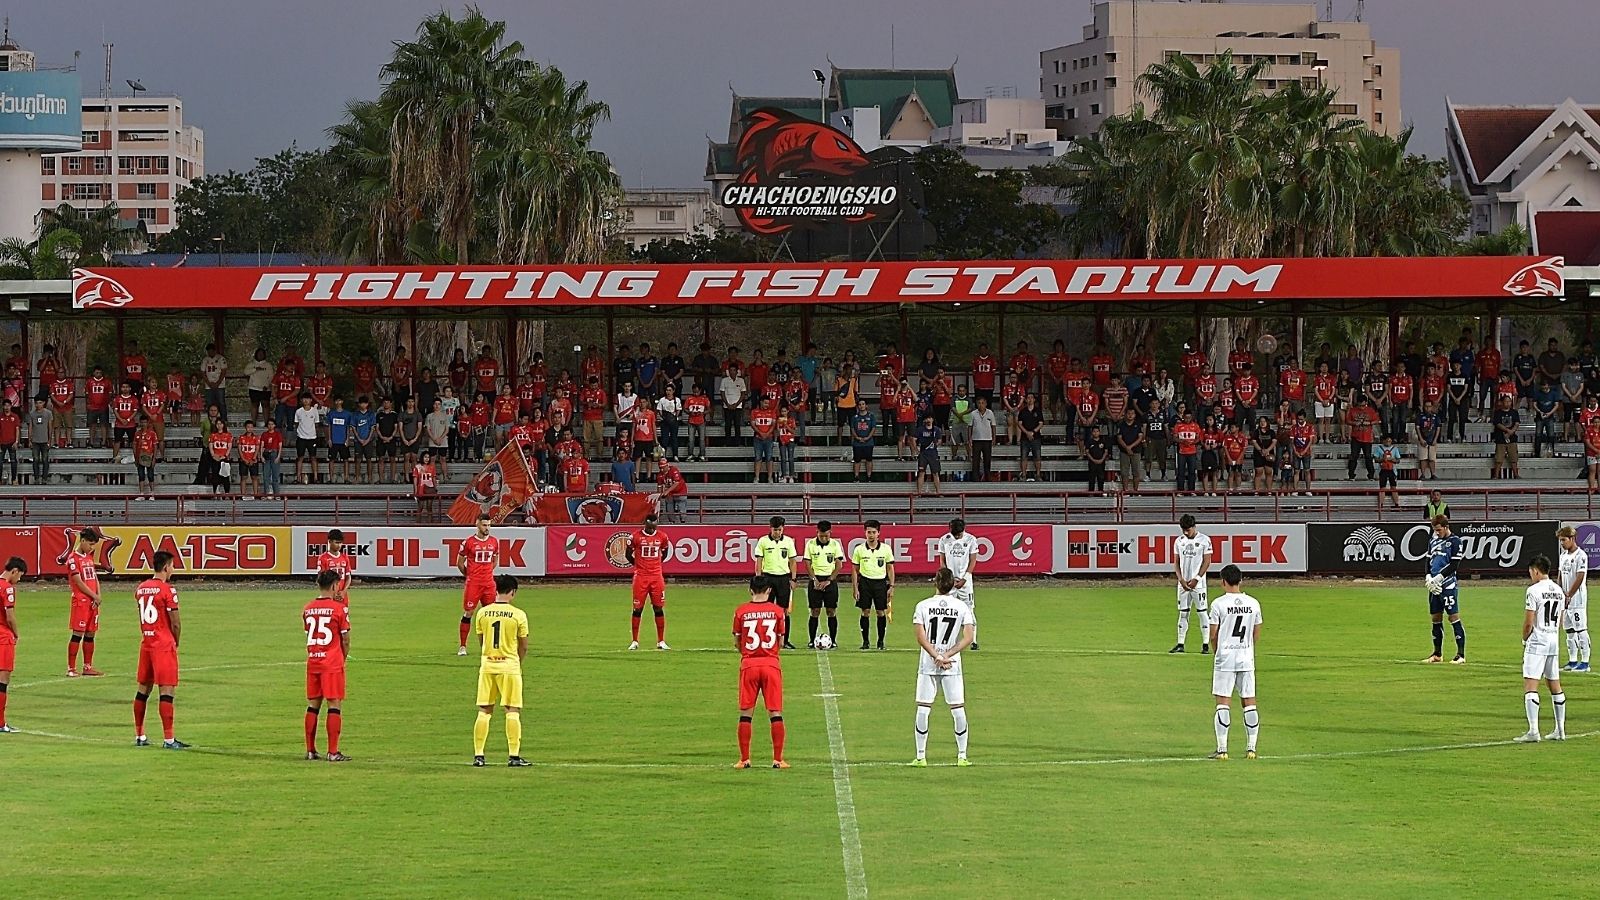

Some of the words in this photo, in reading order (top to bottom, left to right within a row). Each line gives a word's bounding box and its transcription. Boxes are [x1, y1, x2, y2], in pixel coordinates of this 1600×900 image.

[724, 186, 897, 205] CHACHOENGSAO
[756, 206, 788, 216] HI-TEK
[790, 206, 838, 216] FOOTBALL
[840, 206, 865, 216] CLUB
[250, 270, 660, 301] FIGHTING
[677, 269, 881, 298] FISH
[899, 264, 1284, 296] STADIUM
[126, 534, 276, 571] M-150
[308, 544, 370, 556] HITEK
[376, 538, 527, 568] HI-TK
[1069, 542, 1132, 554] HI-TEK
[1400, 525, 1524, 568] Cang
[1198, 592, 1206, 601] 19
[1443, 595, 1456, 606] 25
[139, 596, 158, 624] 16
[743, 611, 776, 620] SARAWUT
[929, 608, 959, 616] MOACIR
[1227, 606, 1253, 614] MANUS
[1544, 601, 1559, 627] 14
[1573, 612, 1580, 621] 8
[305, 616, 333, 646] 25
[491, 620, 501, 649] 1
[743, 619, 777, 650] 33
[929, 616, 957, 645] 17
[1231, 615, 1247, 643] 4
